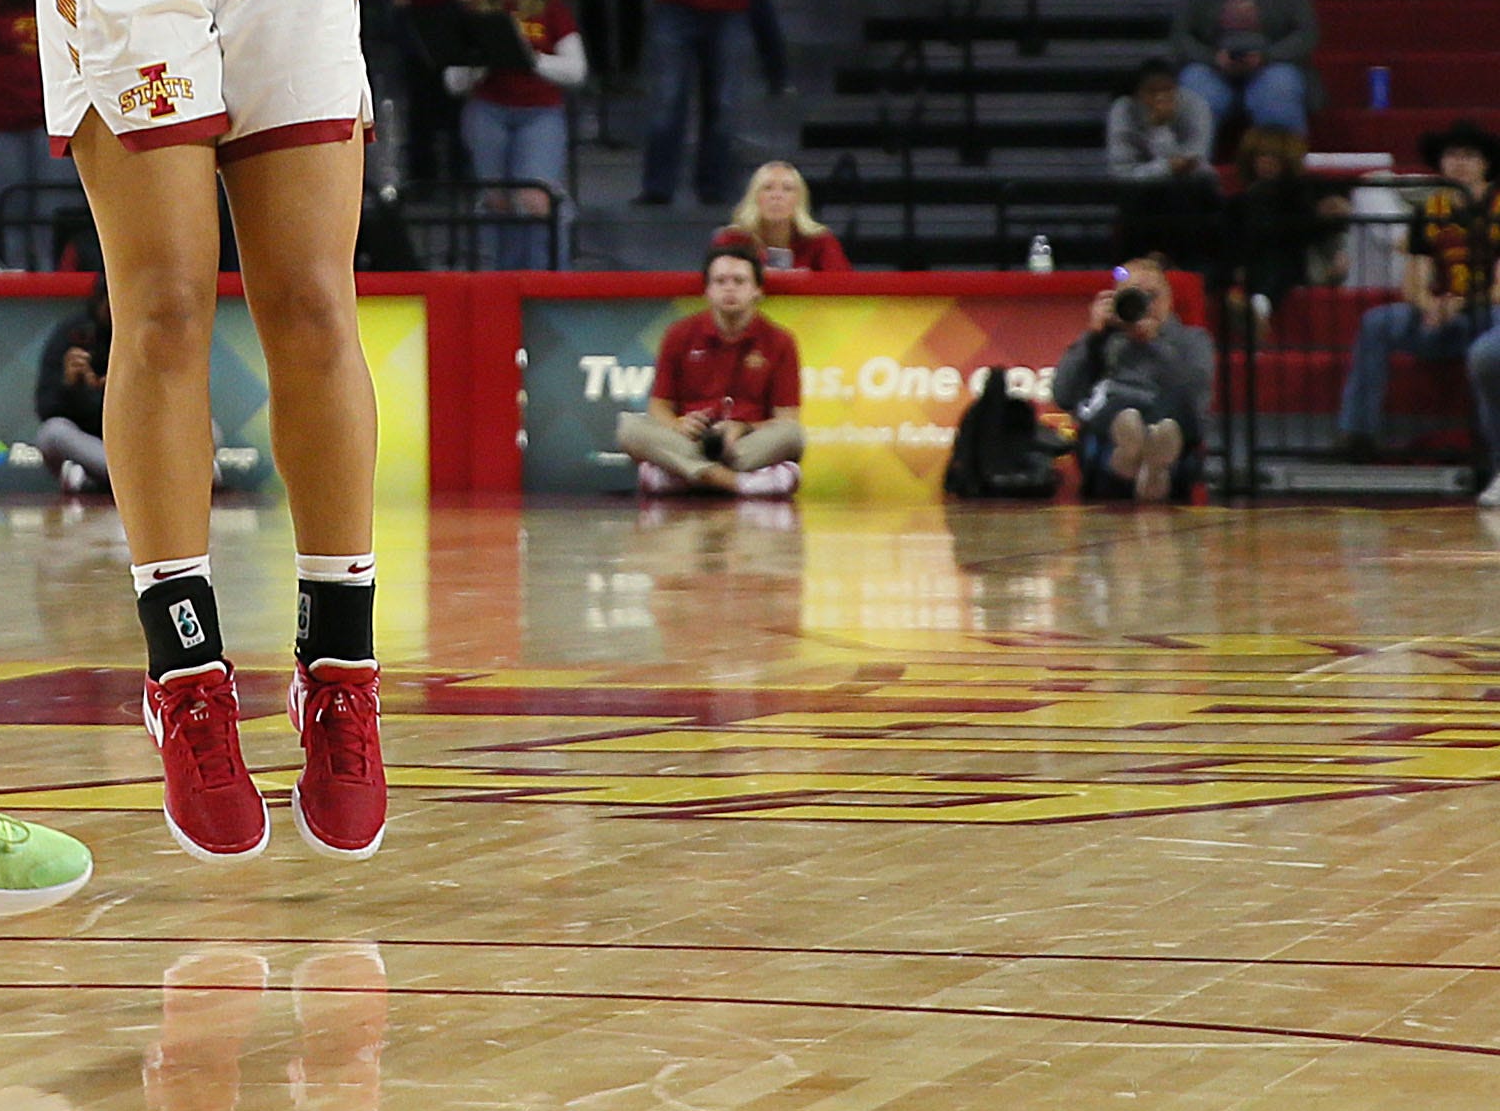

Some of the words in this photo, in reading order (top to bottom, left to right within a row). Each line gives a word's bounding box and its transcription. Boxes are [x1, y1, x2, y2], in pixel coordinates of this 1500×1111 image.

[118, 76, 194, 115] STATE
[579, 355, 656, 400] Tw
[857, 357, 963, 401] One
